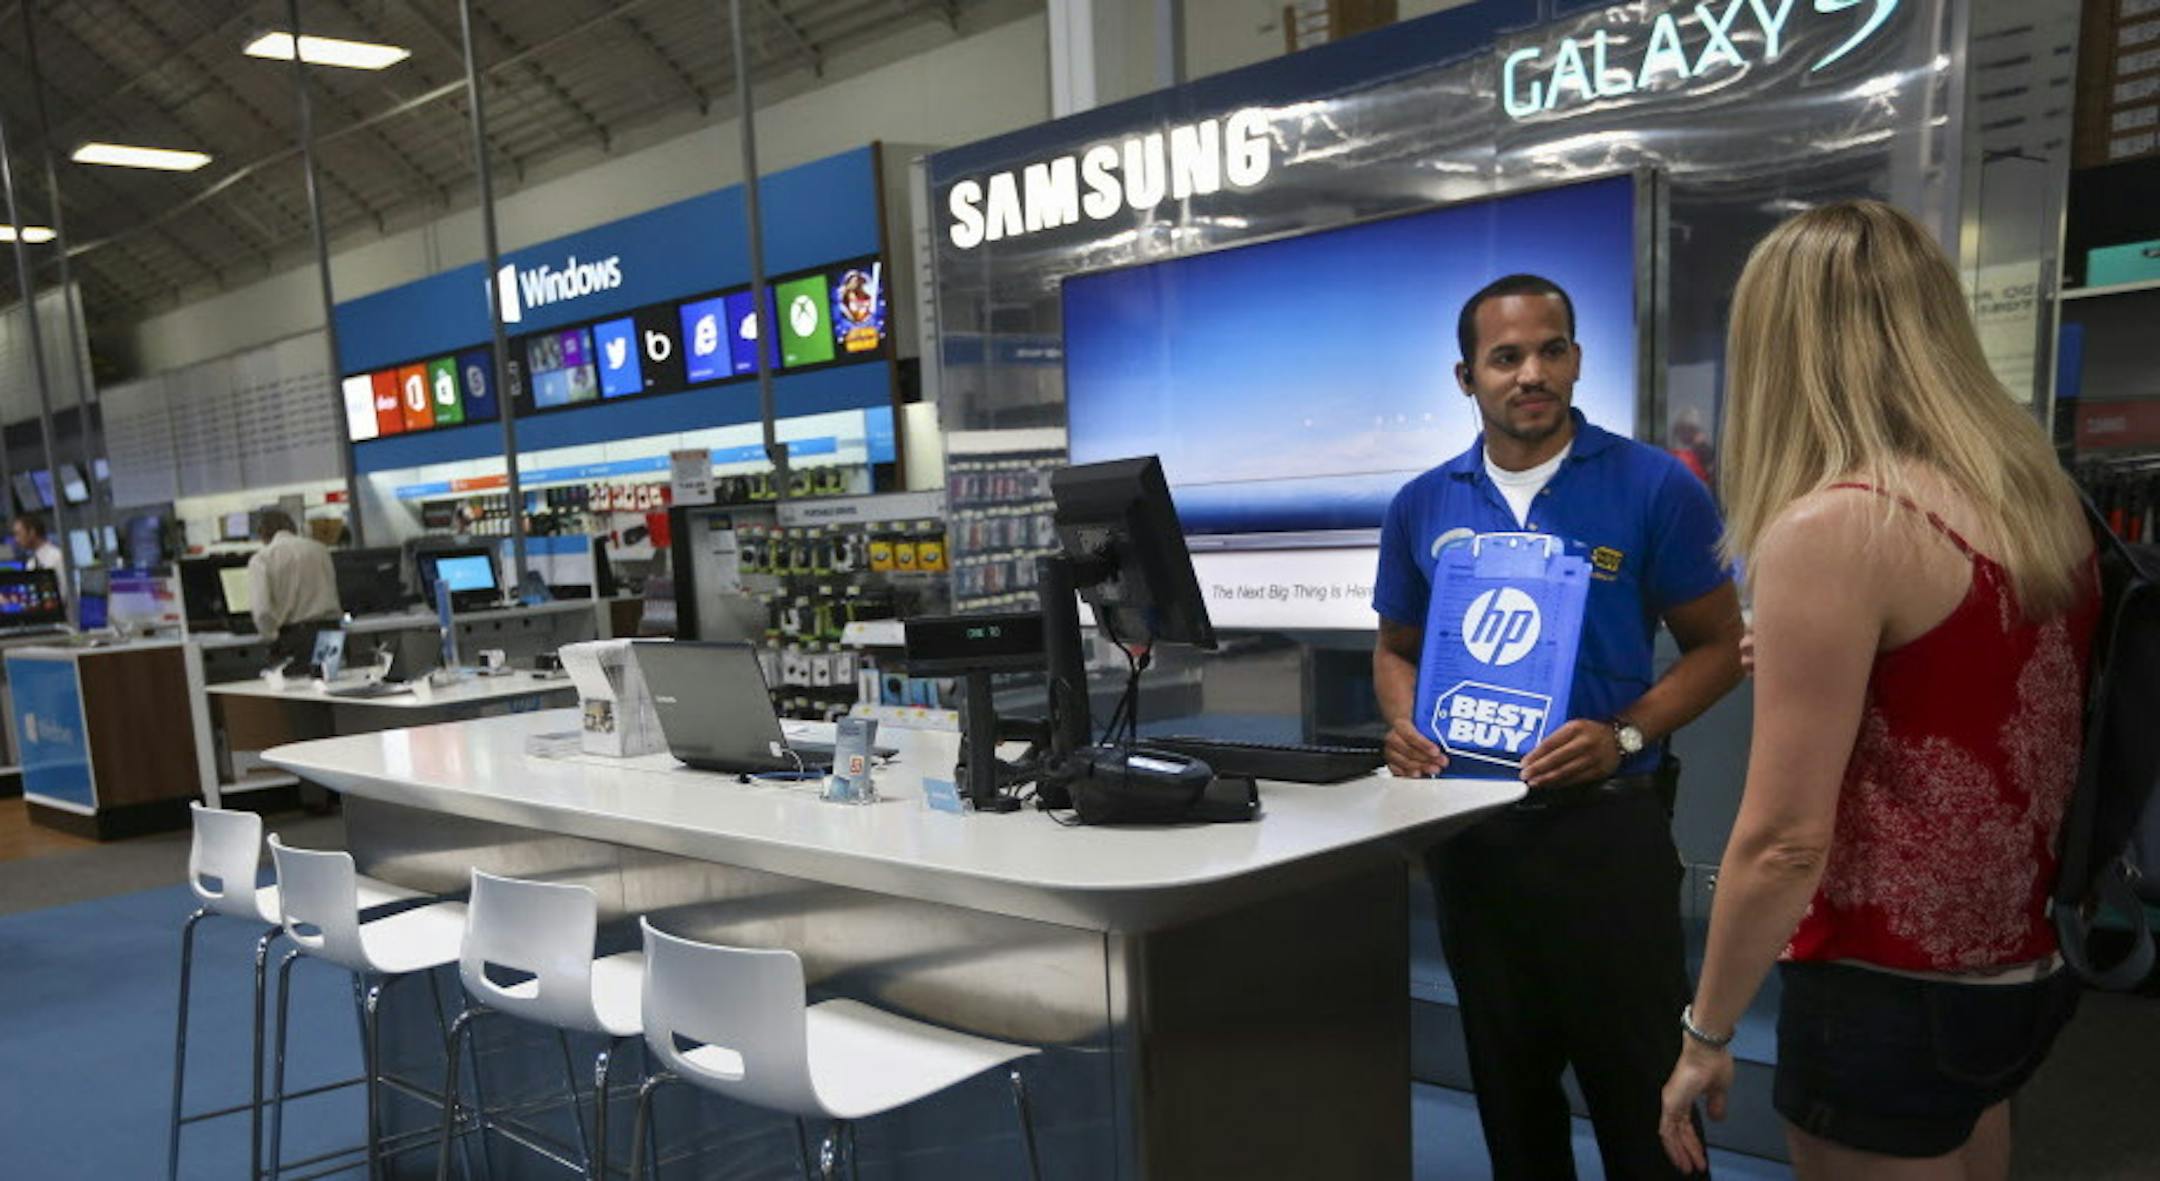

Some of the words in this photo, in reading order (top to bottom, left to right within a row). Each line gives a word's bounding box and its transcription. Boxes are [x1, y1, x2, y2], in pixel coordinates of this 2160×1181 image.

[1502, 0, 1794, 119] GALAXY
[948, 106, 1272, 249] SAMSUNG
[520, 254, 621, 310] Windows
[1212, 584, 1234, 600] The
[1237, 584, 1266, 600] Next
[1268, 584, 1290, 602] Big
[1293, 584, 1328, 602] Thing
[1469, 587, 1534, 666] hp
[1447, 721, 1532, 754] BUY
[1449, 694, 1544, 730] BEST
